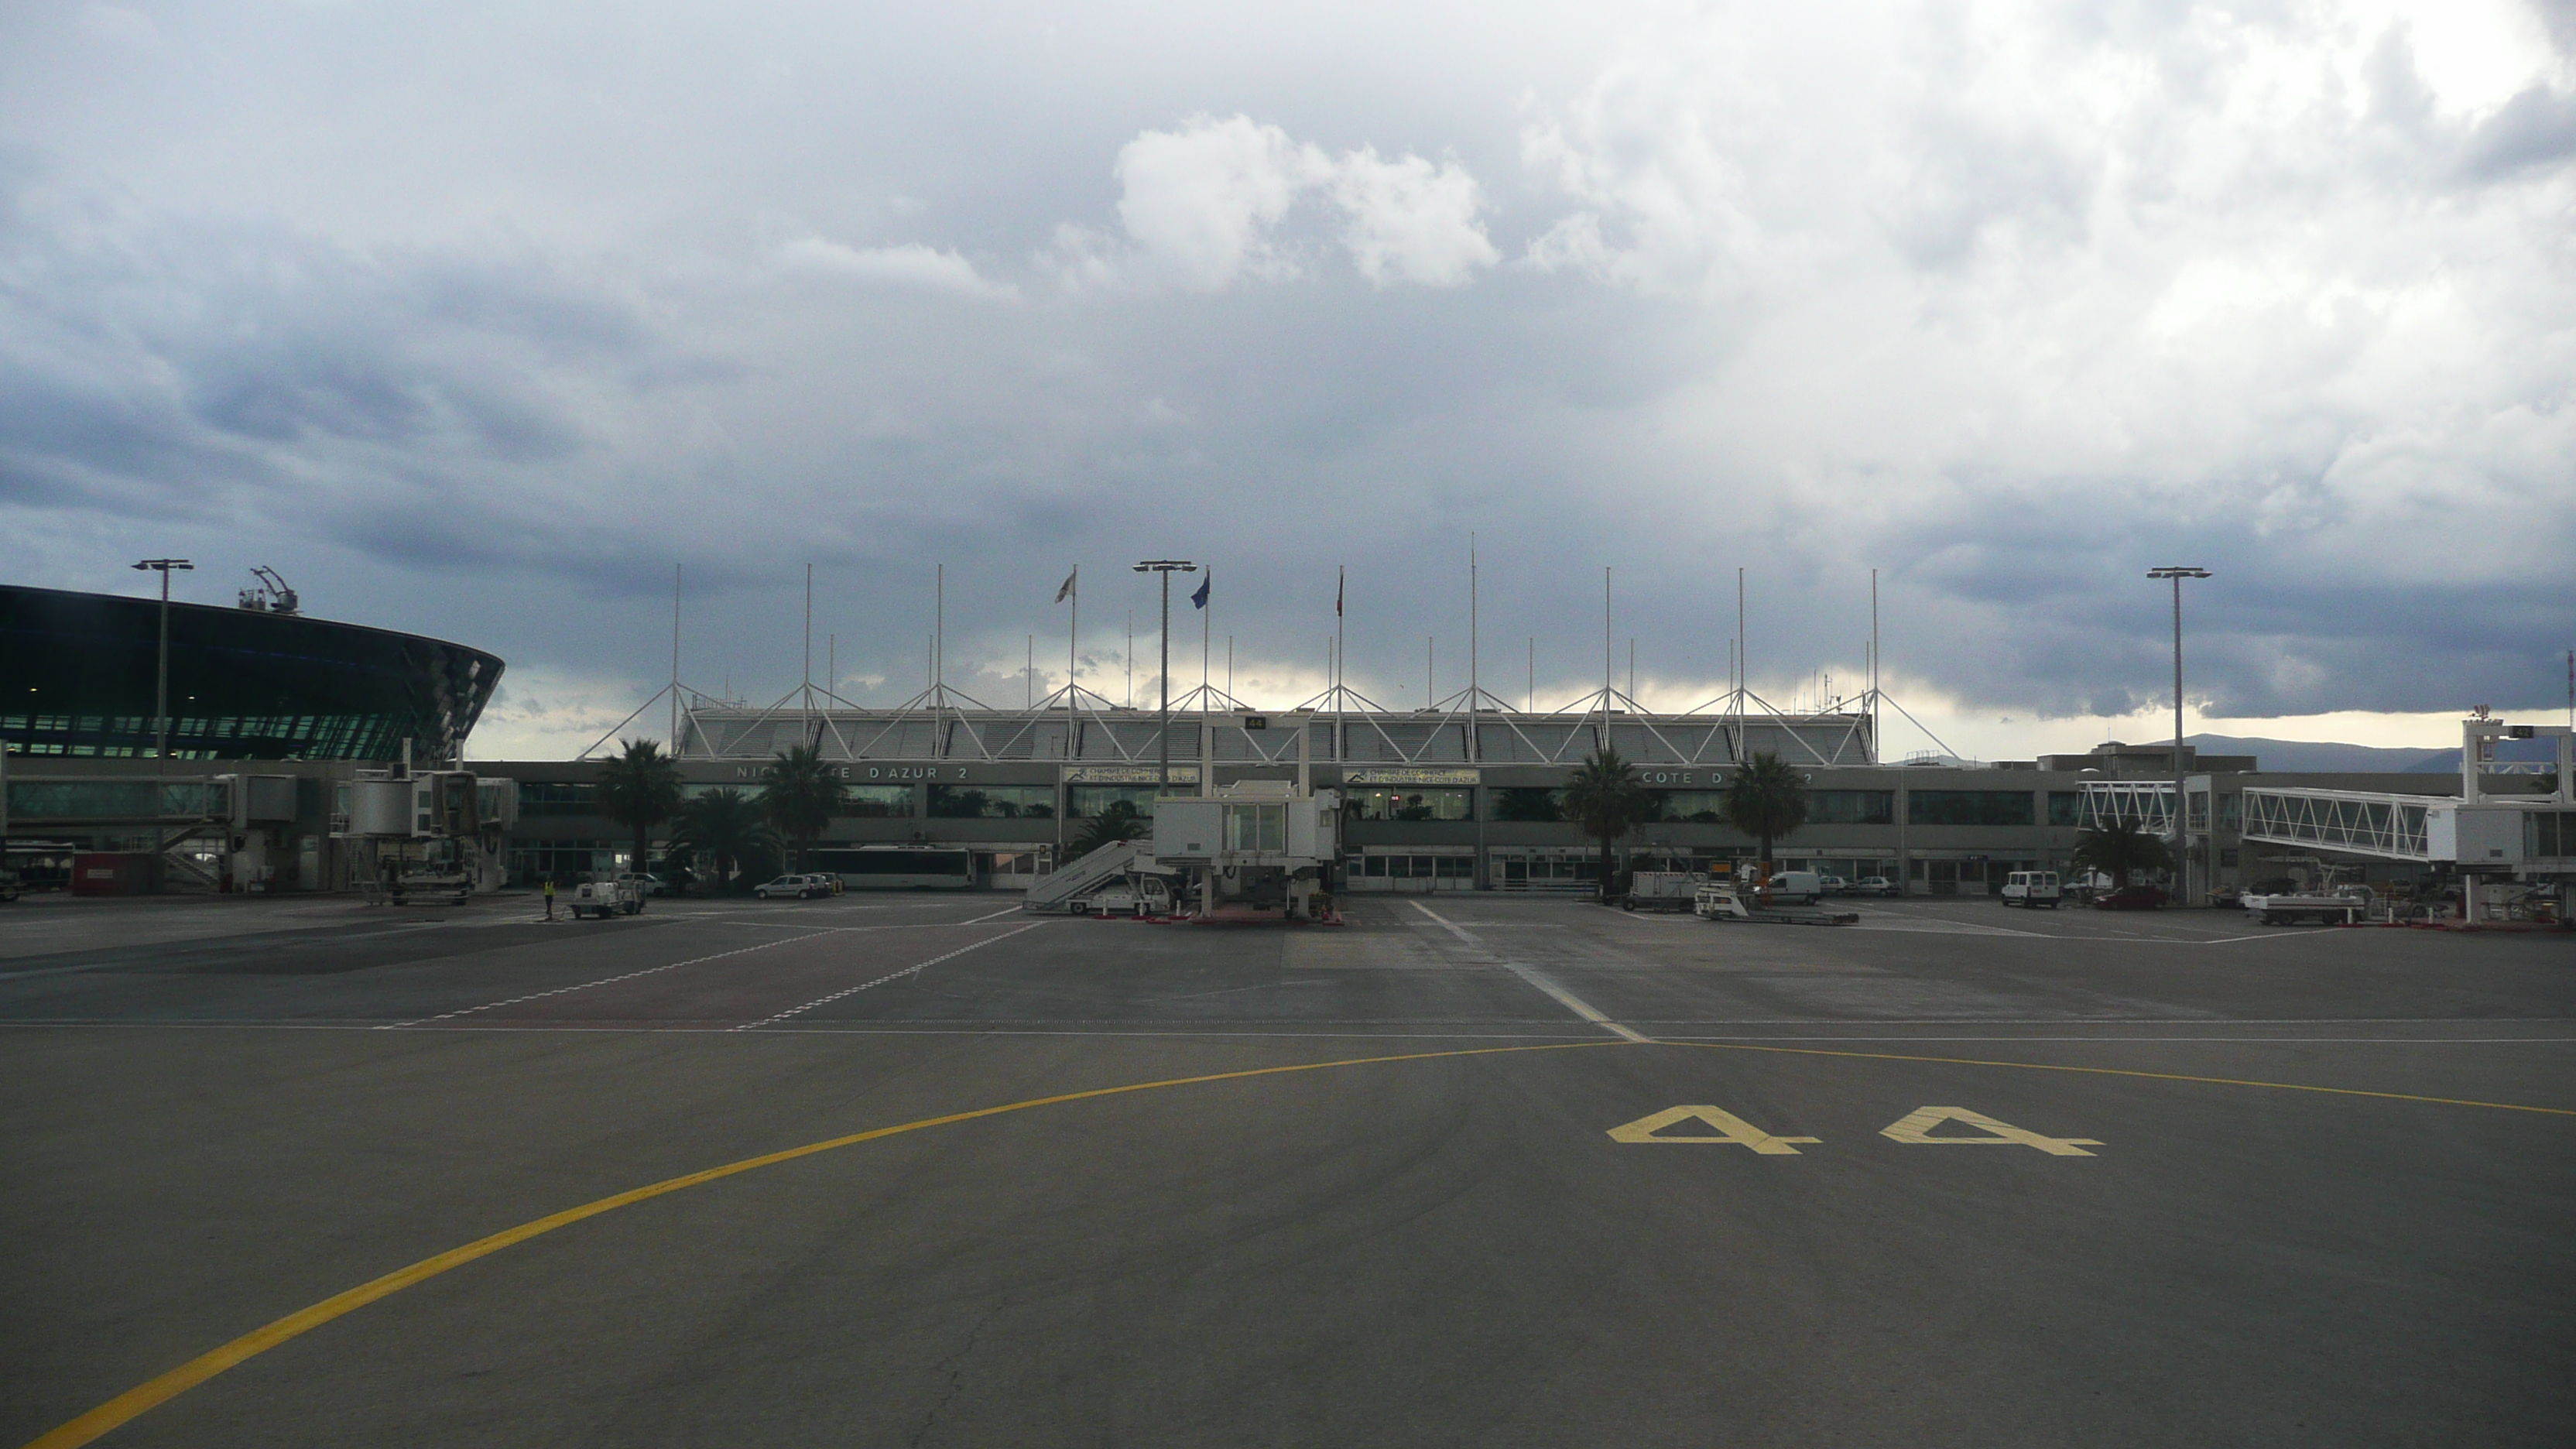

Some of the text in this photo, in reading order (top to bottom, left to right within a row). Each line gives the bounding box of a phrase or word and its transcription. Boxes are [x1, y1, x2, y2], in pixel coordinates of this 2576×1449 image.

[1249, 719, 1262, 728] 44
[869, 767, 937, 779] D'AZUR
[958, 768, 967, 779] 2
